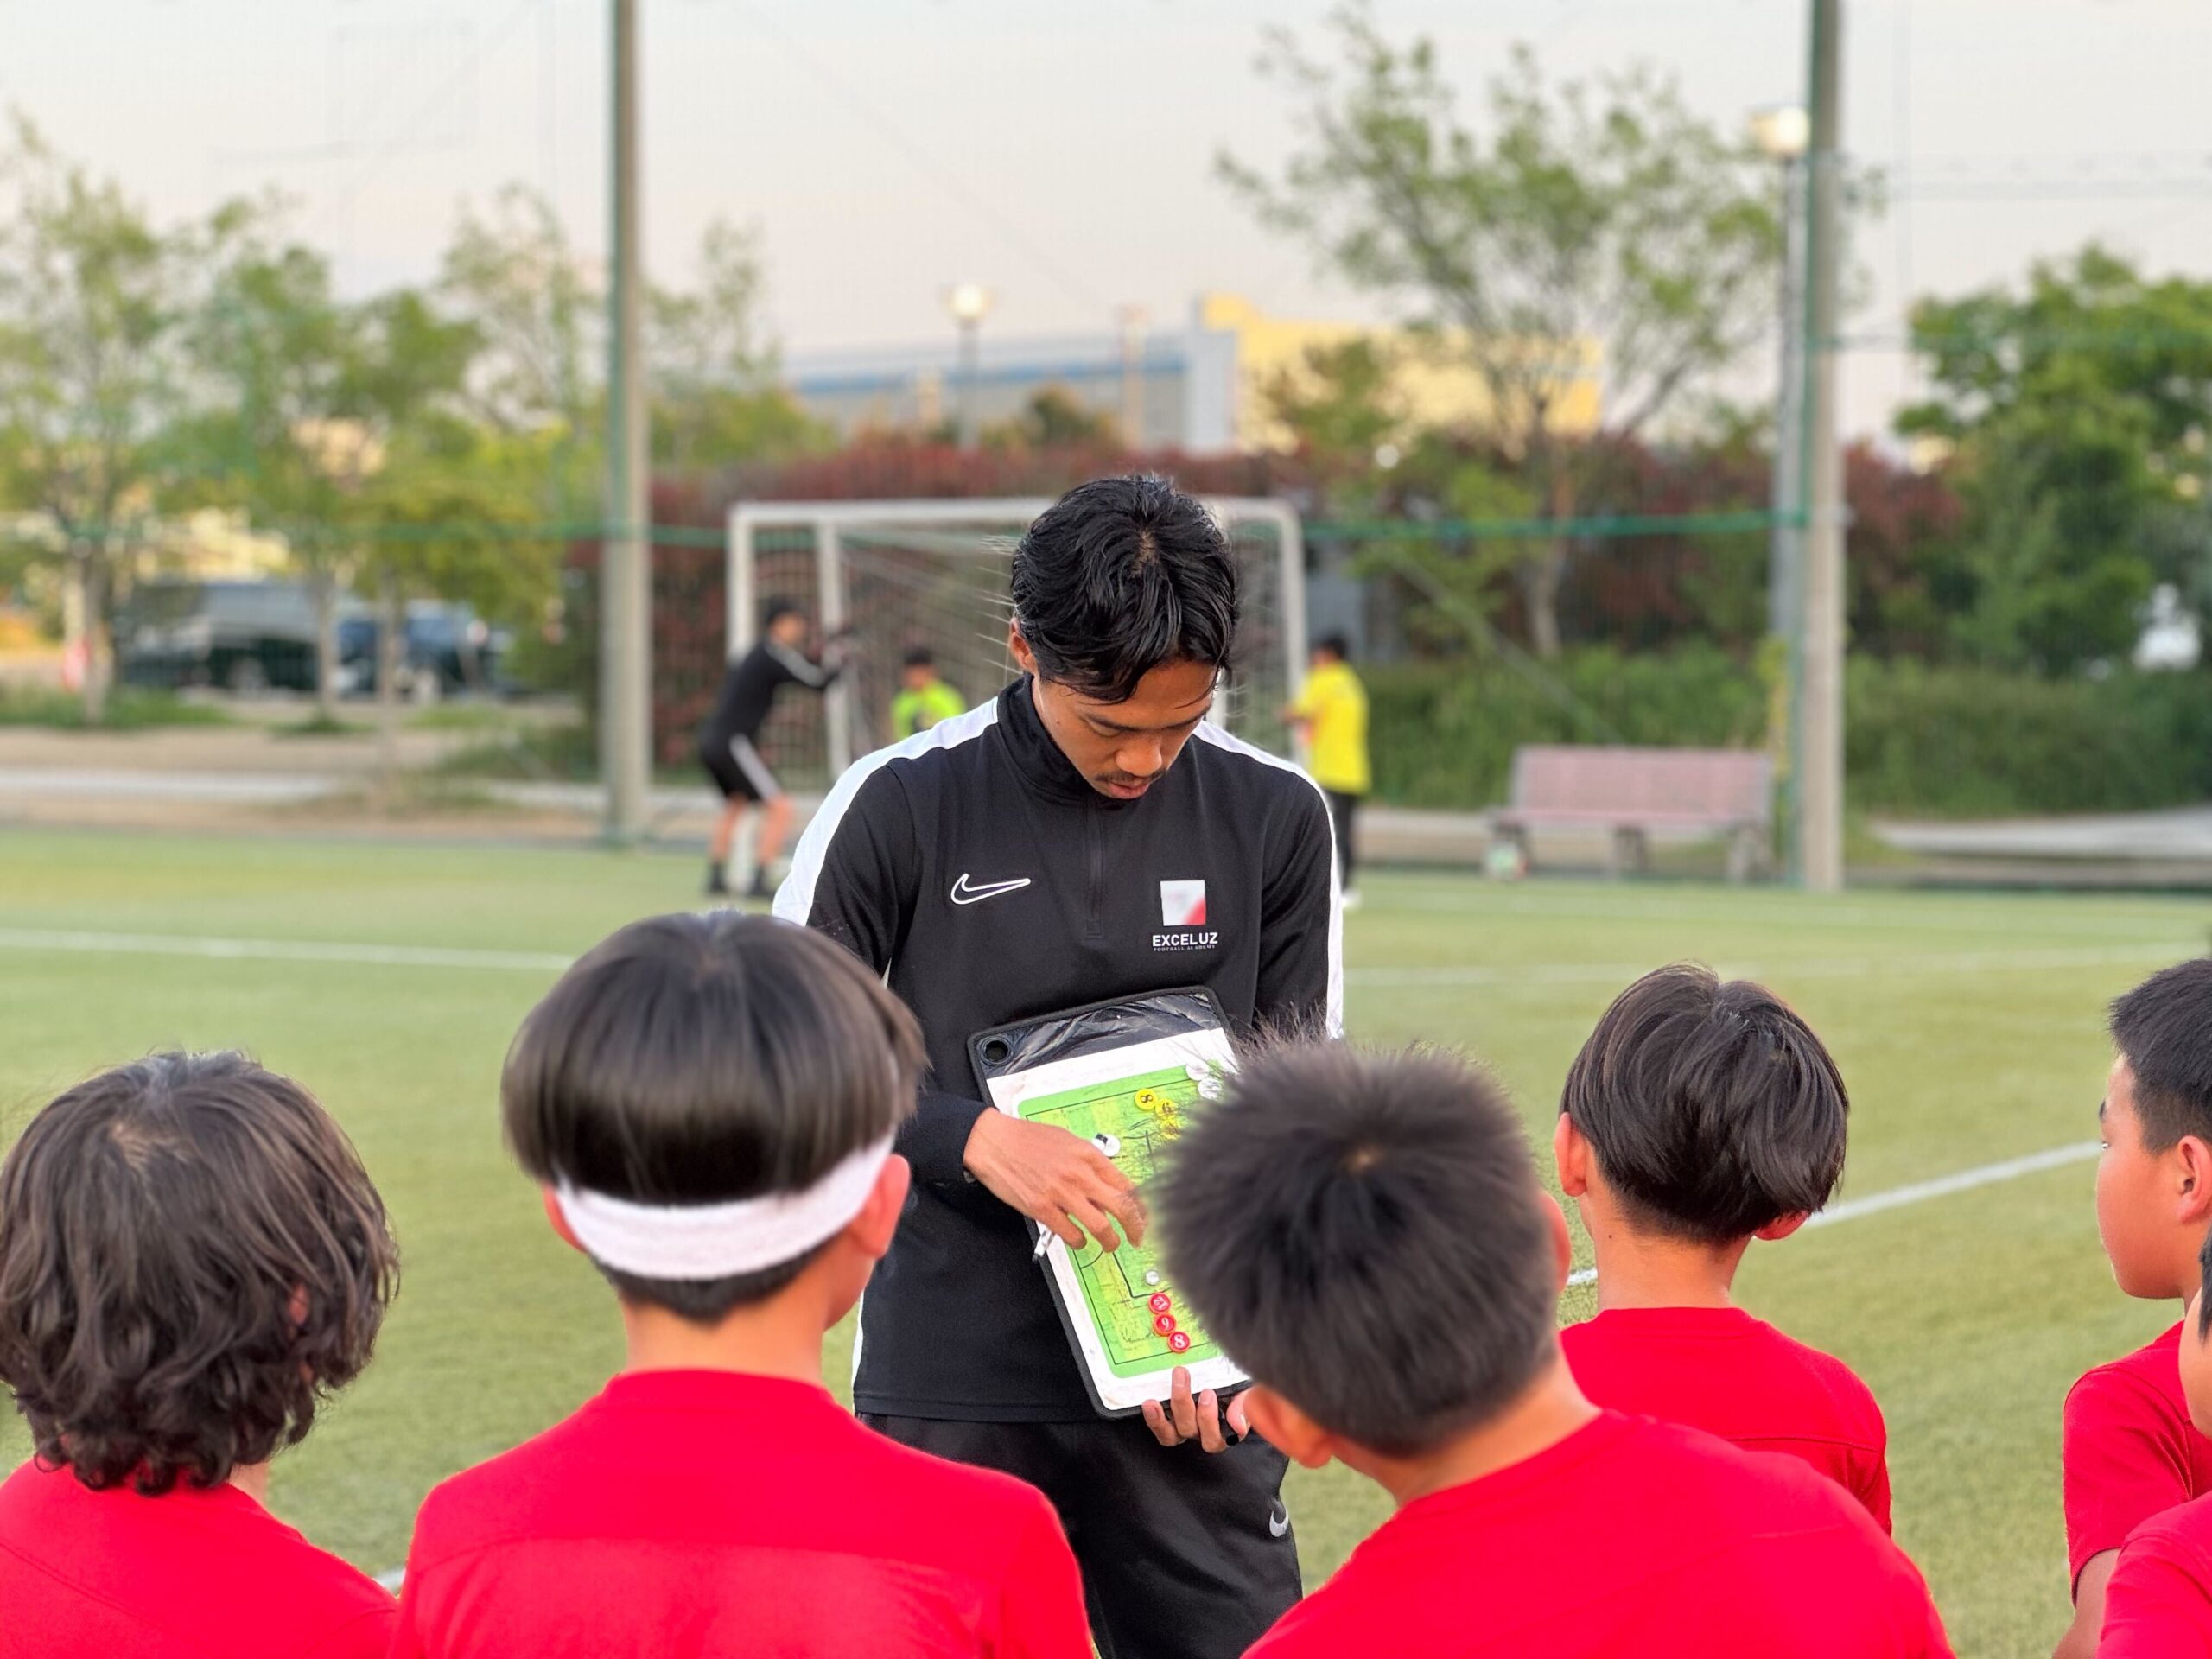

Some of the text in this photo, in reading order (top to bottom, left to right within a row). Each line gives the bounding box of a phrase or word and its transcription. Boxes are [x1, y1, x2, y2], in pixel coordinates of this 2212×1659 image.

[1152, 931, 1218, 947] EXCELUZ
[1141, 1094, 1154, 1103] 8
[1173, 1334, 1185, 1348] 8
